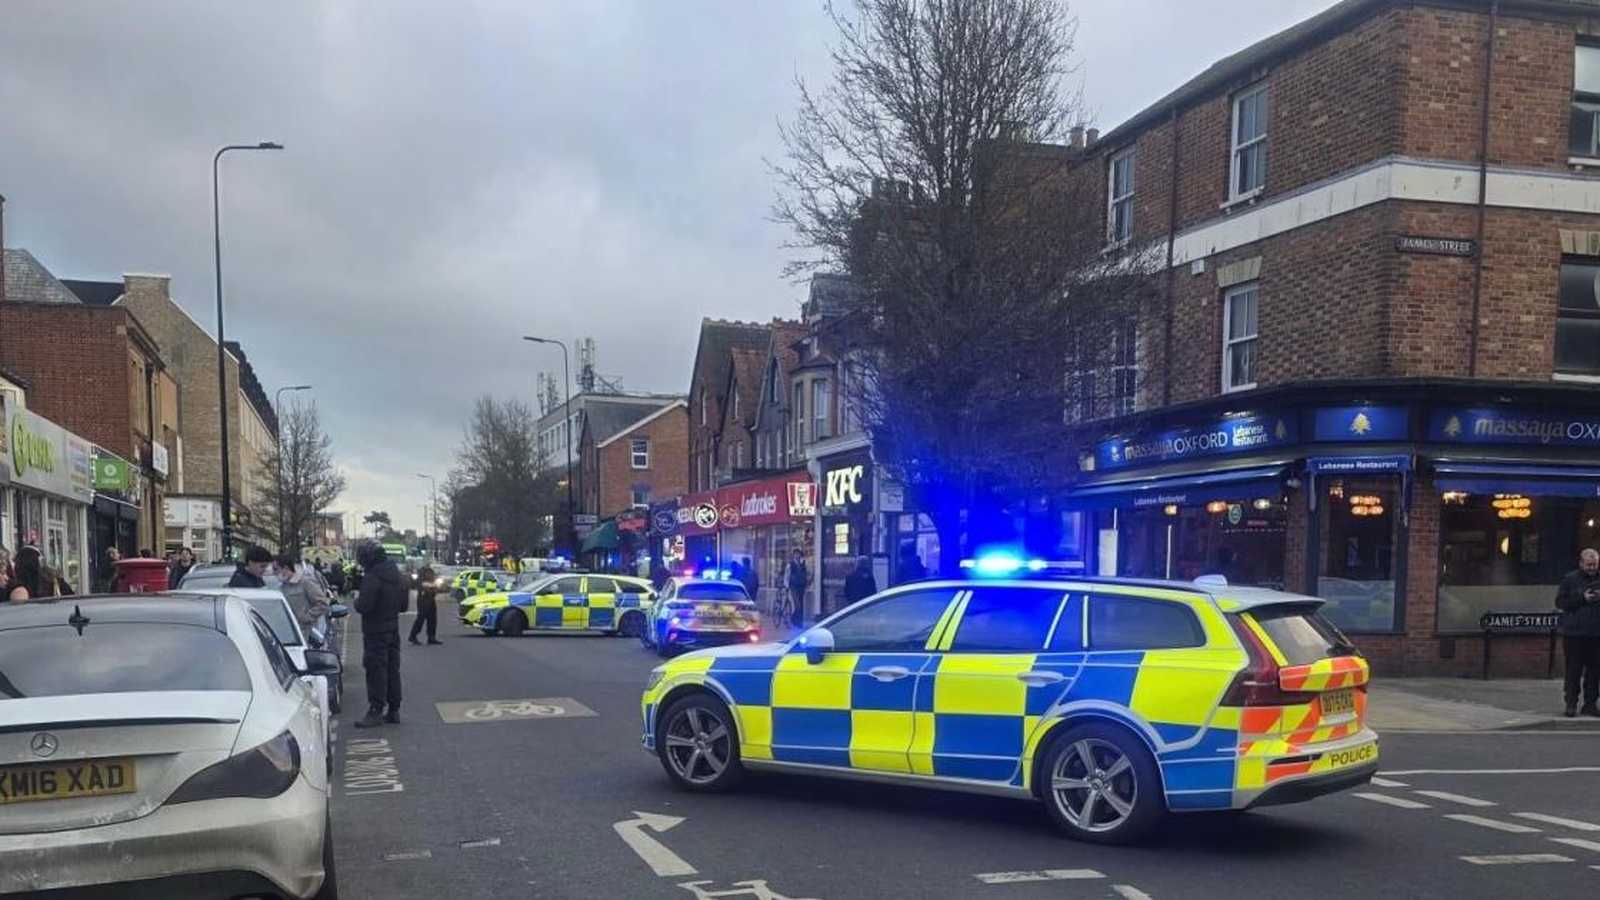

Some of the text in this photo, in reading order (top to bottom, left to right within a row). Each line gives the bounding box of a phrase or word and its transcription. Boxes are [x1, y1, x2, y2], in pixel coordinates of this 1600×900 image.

[1402, 239, 1470, 251] JAMES STREET
[1356, 461, 1398, 469] Restaurant
[825, 465, 863, 507] KFC
[741, 489, 777, 517] Ladbrokes
[793, 507, 813, 515] KFC
[1489, 615, 1560, 627] JAMES STREET
[1331, 746, 1372, 769] POLICE
[67, 763, 124, 792] XAD
